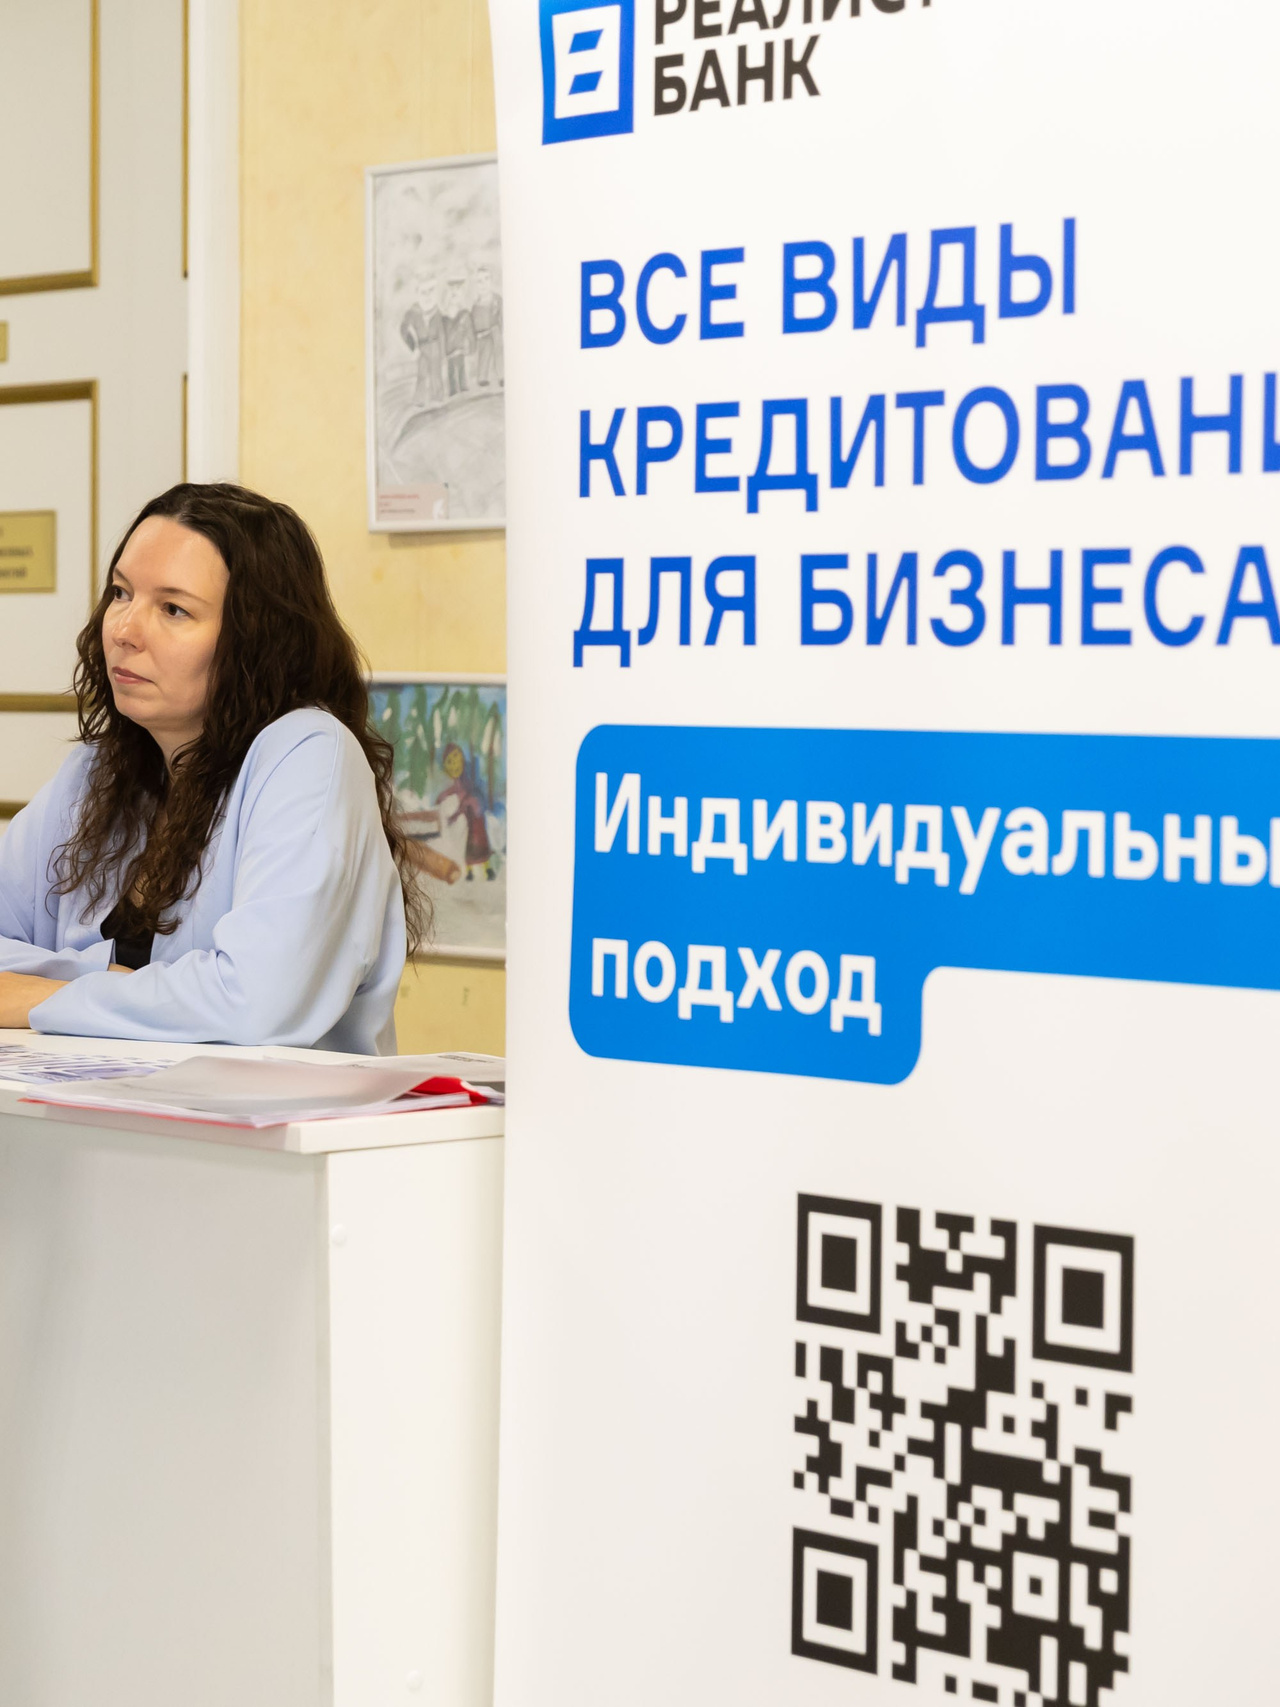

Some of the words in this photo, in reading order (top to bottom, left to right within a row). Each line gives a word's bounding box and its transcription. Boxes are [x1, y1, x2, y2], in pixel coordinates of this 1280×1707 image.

[655, 34, 819, 115] БАНК
[581, 247, 744, 349] ВСЕ
[783, 218, 1075, 348] ВИДЫ
[580, 373, 1280, 514] КРЕДИТОВАН
[573, 555, 756, 667] ДЛЯ
[801, 546, 1280, 647] БИЗНЕСА
[595, 773, 1280, 894] Индивидуальны
[592, 938, 881, 1036] подход
